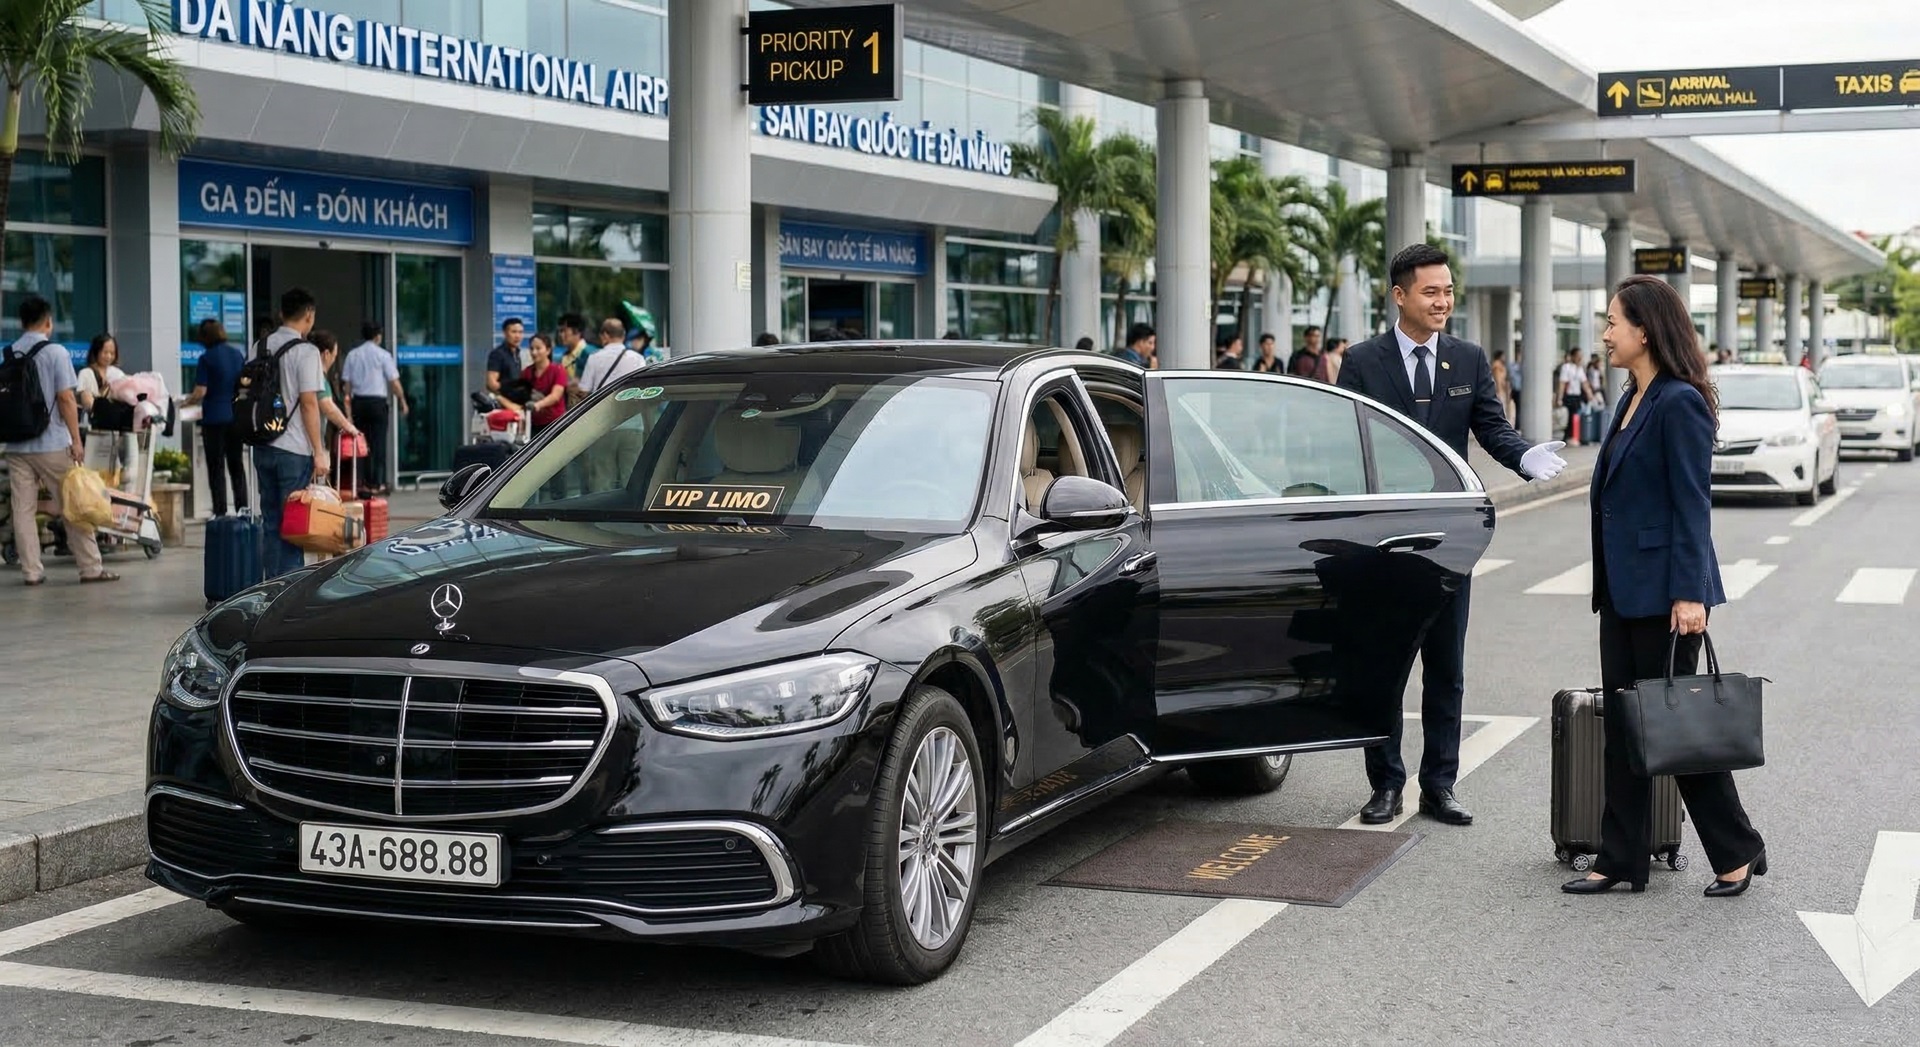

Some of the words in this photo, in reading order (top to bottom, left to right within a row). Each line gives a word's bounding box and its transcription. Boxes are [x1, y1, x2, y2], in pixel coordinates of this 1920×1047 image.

[760, 29, 854, 53] PRIORITY
[862, 31, 880, 75] 1
[365, 19, 606, 105] INTERNATIONAL
[610, 67, 669, 115] AIRP
[770, 59, 844, 82] PICKUP
[1669, 75, 1731, 90] ARRIVAL
[1669, 93, 1723, 107] ARRIVAL
[1725, 90, 1757, 105] HALL
[1835, 74, 1893, 94] TAXIS
[814, 109, 852, 147] BAY
[200, 182, 238, 214] GA
[244, 176, 296, 218] ĐẾN
[317, 187, 367, 224] ĐÓN
[374, 193, 448, 230] KHÁCH
[665, 489, 704, 507] VIP
[706, 491, 771, 509] LIMO
[310, 830, 488, 877] 43A-688.88
[1185, 833, 1291, 880] WELCOME
